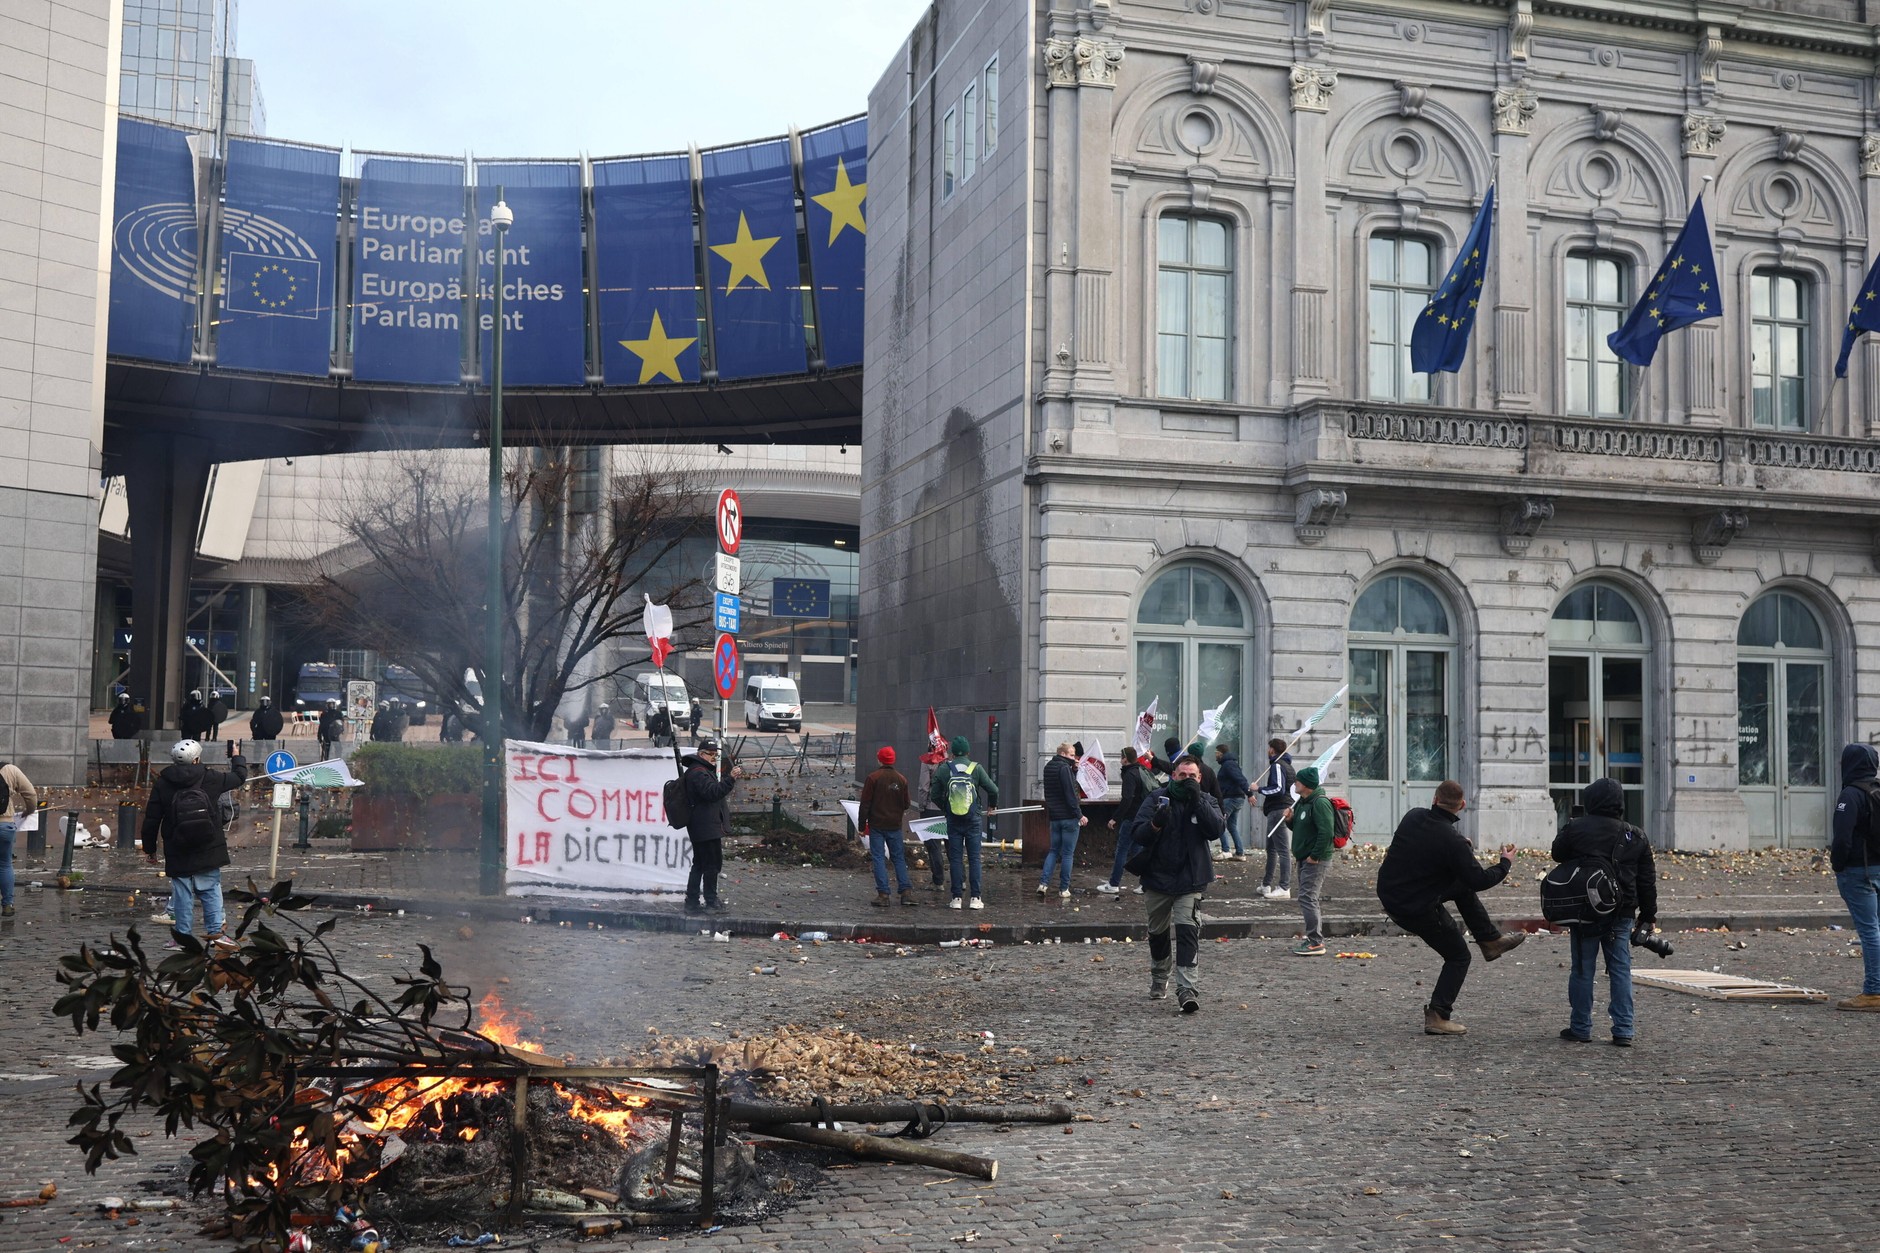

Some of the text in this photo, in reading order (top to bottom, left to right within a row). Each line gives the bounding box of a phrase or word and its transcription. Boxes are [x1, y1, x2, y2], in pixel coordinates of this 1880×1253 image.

[362, 206, 509, 238] Europea
[362, 237, 530, 265] Parliament
[764, 641, 788, 650] Spinelli
[1350, 716, 1378, 725] Station
[1350, 725, 1376, 737] Europe
[512, 756, 581, 783] ICI
[537, 788, 668, 823] COMME
[517, 831, 552, 866] LA
